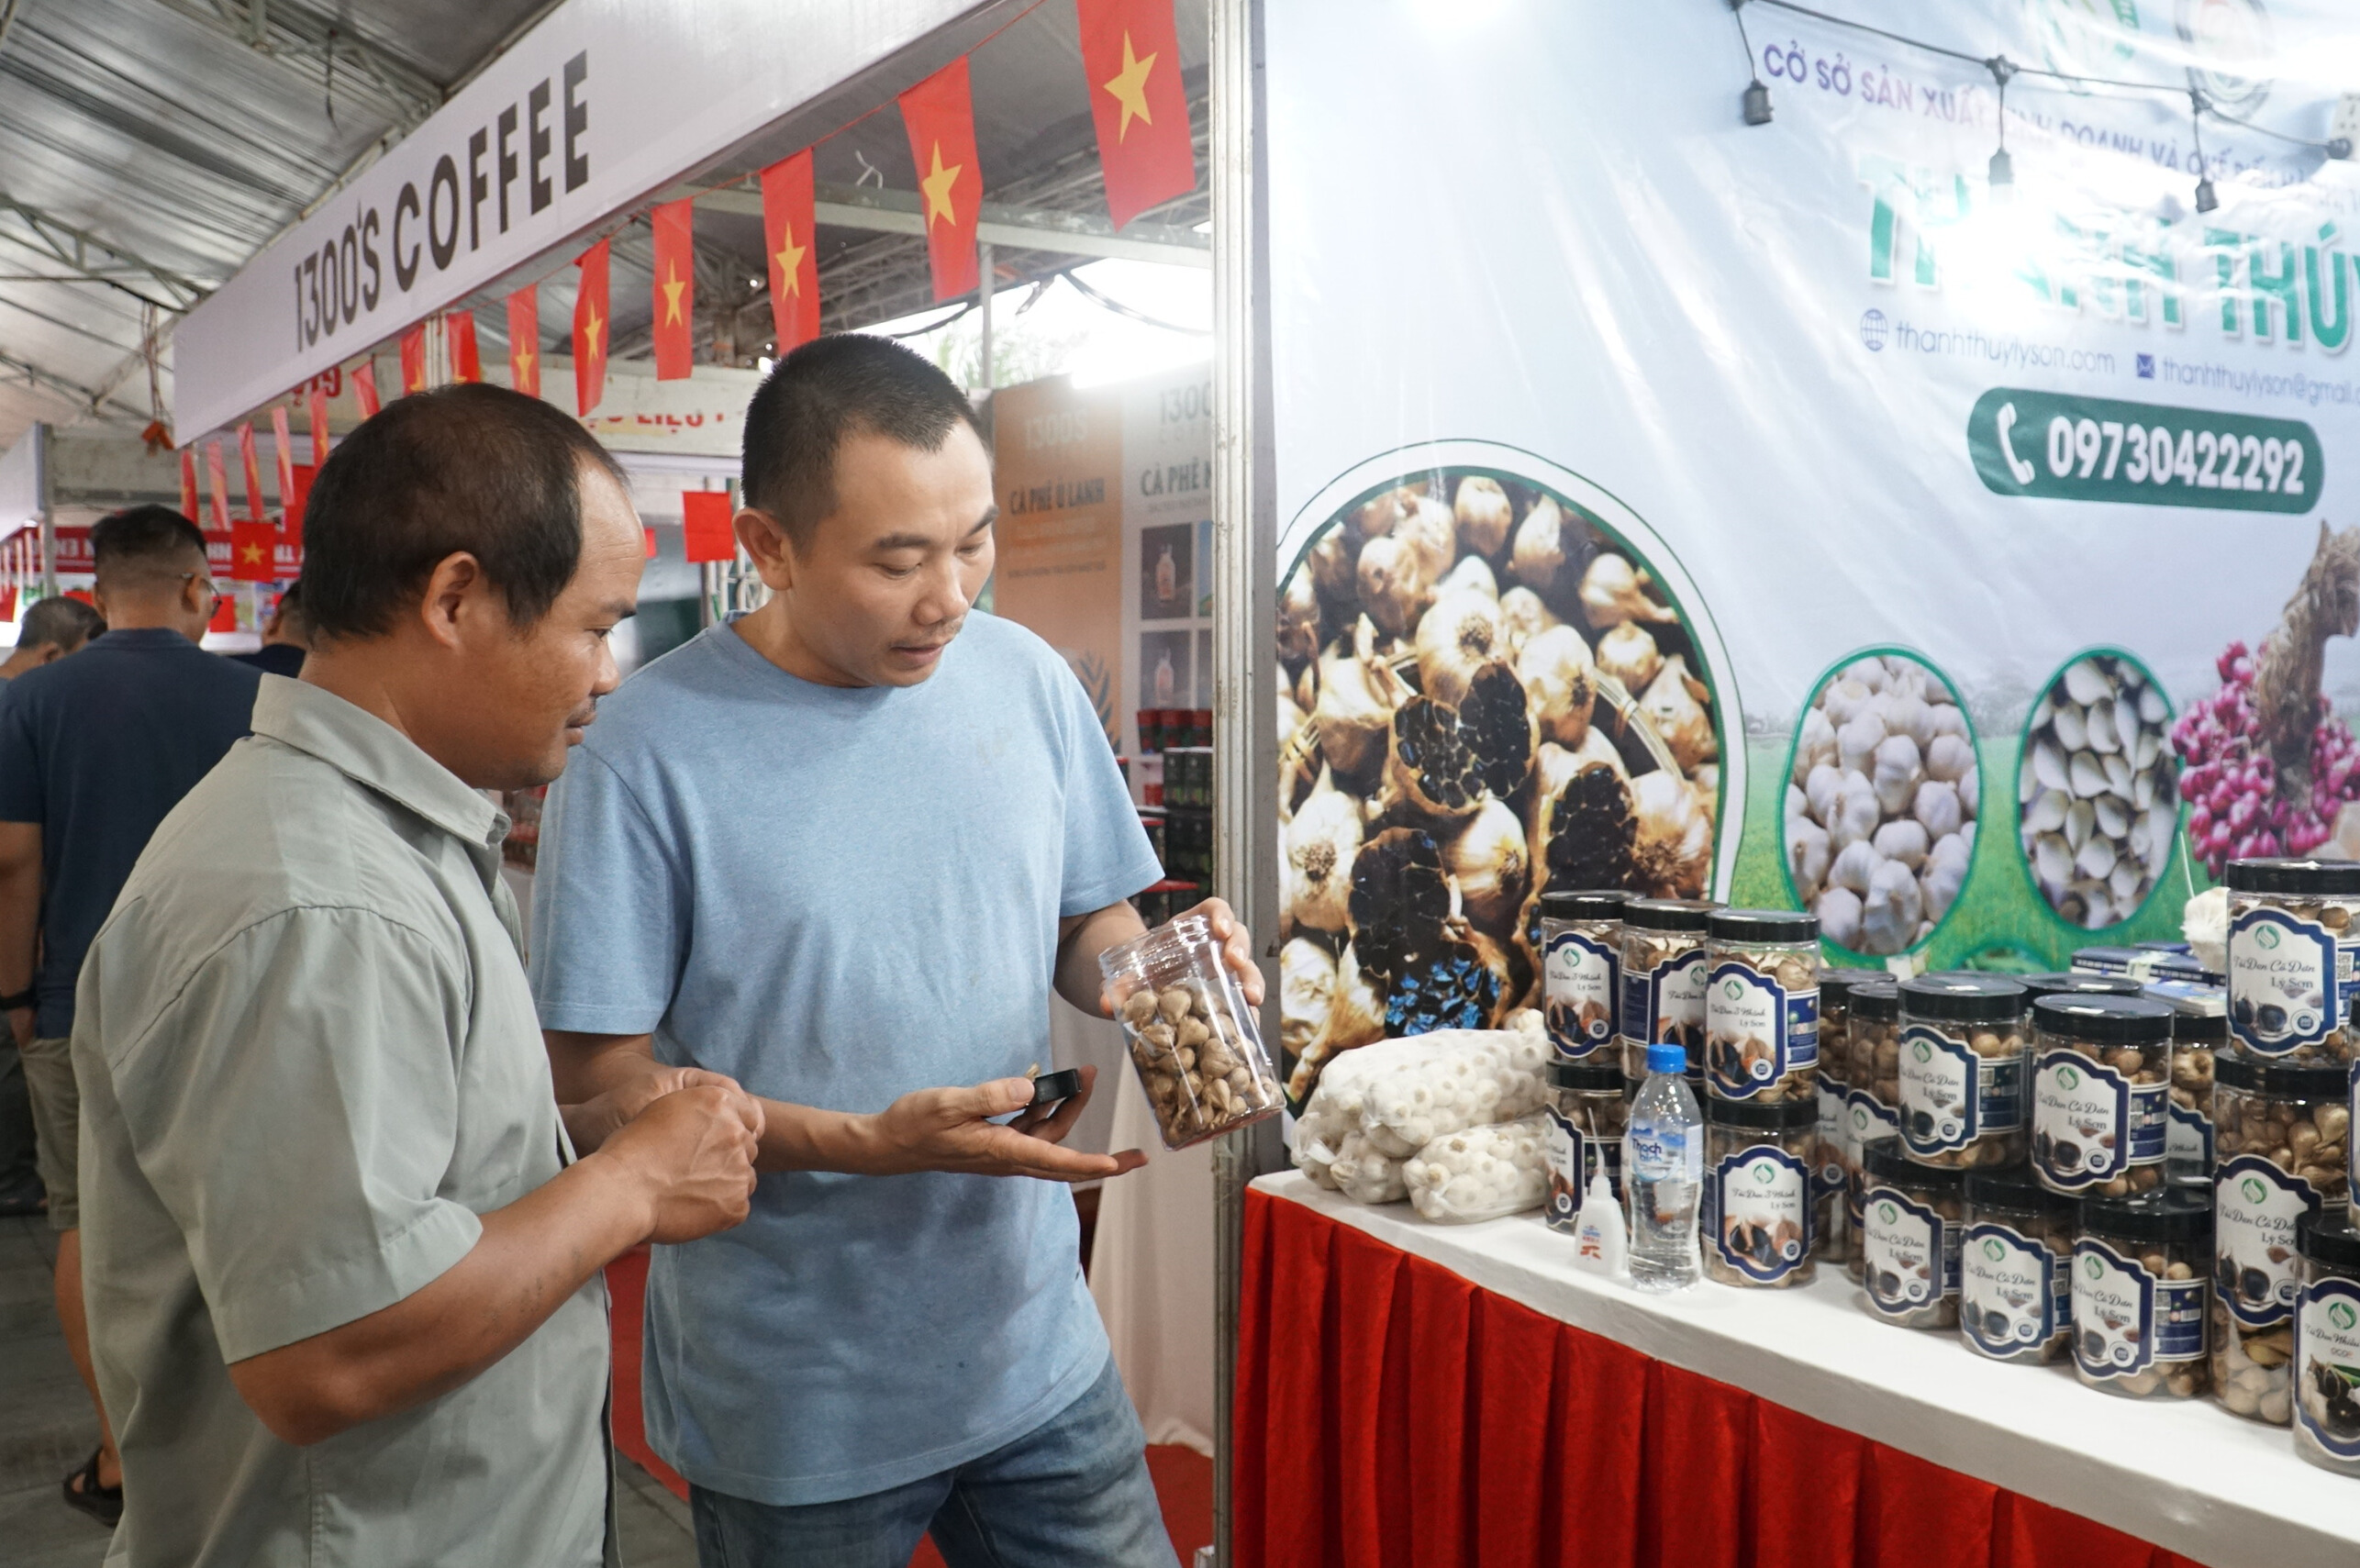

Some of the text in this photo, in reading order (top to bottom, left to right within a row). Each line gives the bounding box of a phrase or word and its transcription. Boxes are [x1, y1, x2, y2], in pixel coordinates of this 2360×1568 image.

[295, 49, 588, 352] 1300'S COFFEE
[2204, 221, 2360, 349] THÚ
[1897, 320, 2116, 374] thanhthuylyson.com
[2047, 416, 2305, 495] 09730422292
